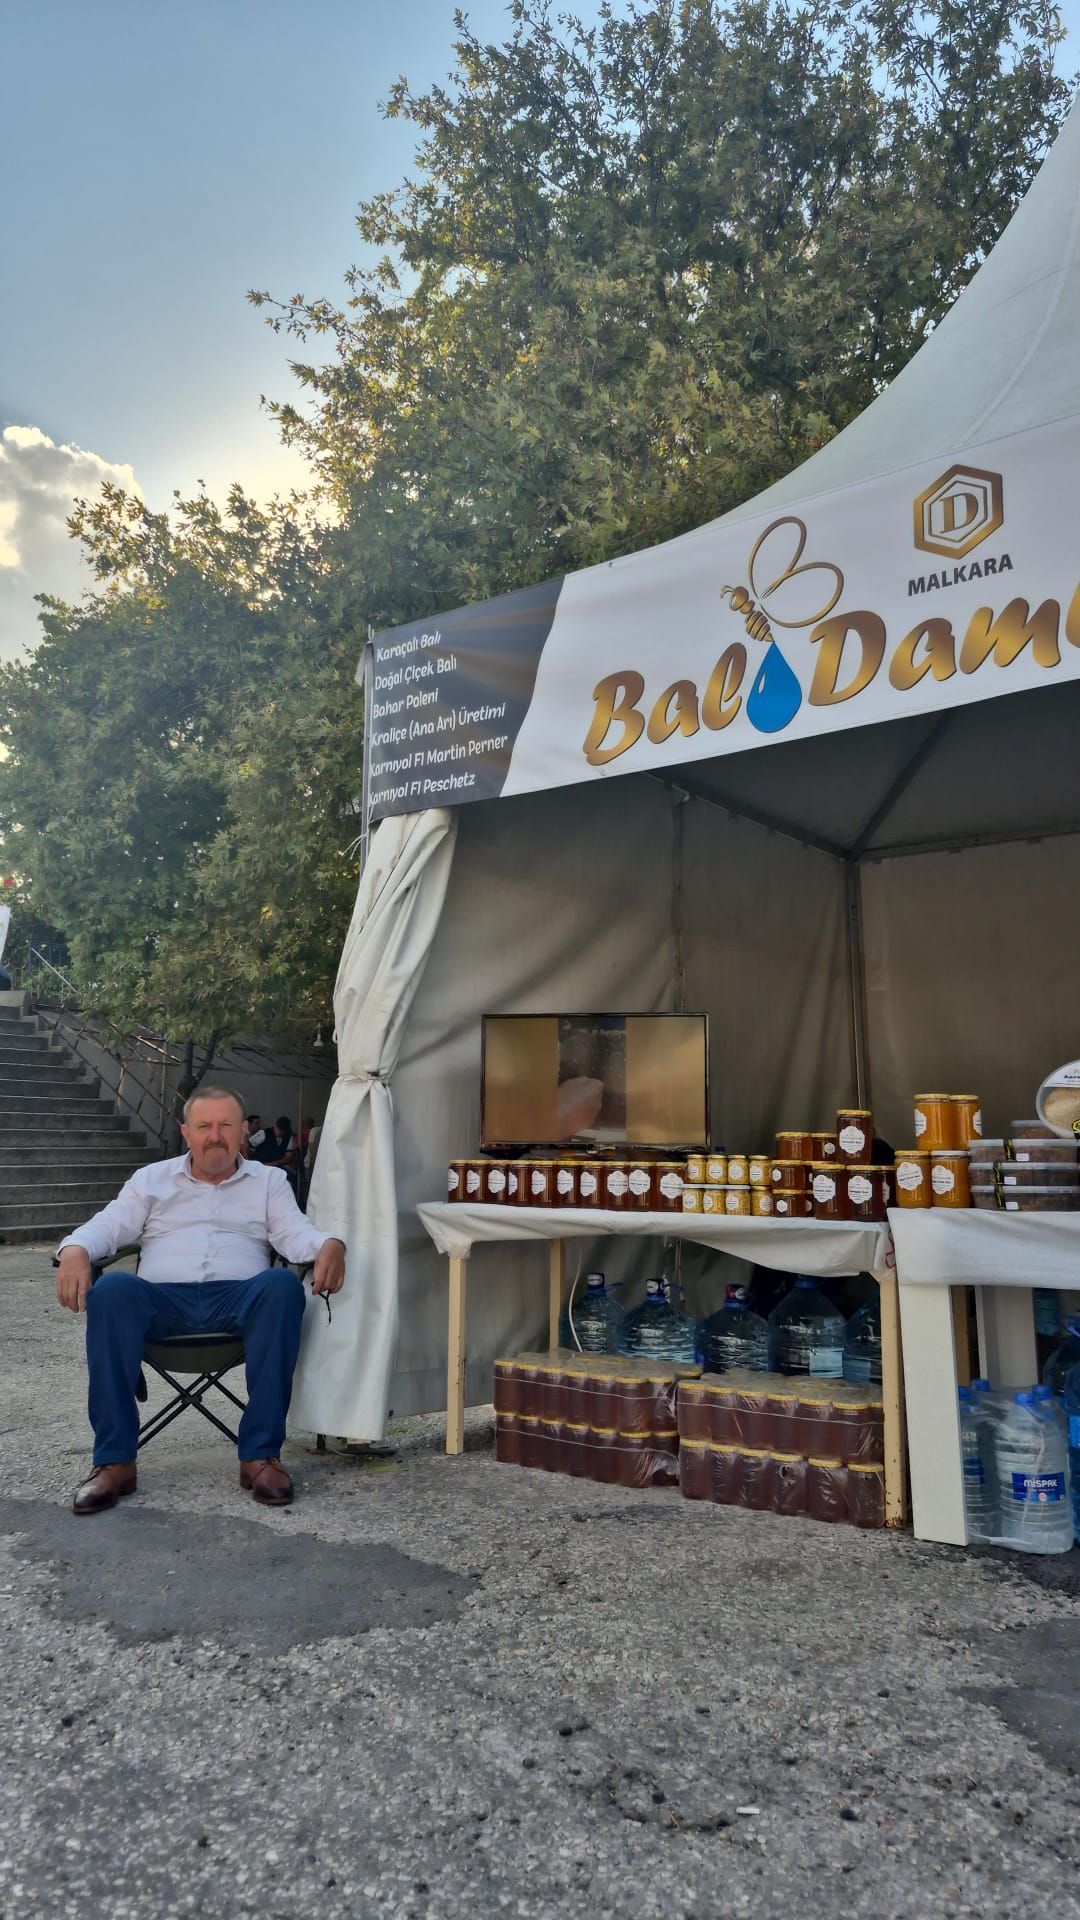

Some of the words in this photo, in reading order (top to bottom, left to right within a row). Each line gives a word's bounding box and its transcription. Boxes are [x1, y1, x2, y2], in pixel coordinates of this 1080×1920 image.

[907, 553, 1014, 597] MALKARA
[376, 636, 419, 662] Karaçalı
[420, 631, 442, 649] Balı
[375, 668, 403, 691] Doğal
[404, 660, 434, 686] Çiçek
[437, 655, 457, 674] Balı
[373, 700, 405, 719] Bahar
[406, 688, 439, 710] Poleni
[583, 642, 748, 767] Bal
[371, 727, 407, 748] Kraliçe
[409, 720, 434, 741] (Ana
[437, 709, 456, 732] Arı)
[458, 703, 506, 726] Üretimi
[427, 743, 466, 765] Martin
[469, 735, 508, 755] Perner
[423, 772, 476, 794] Peschetz
